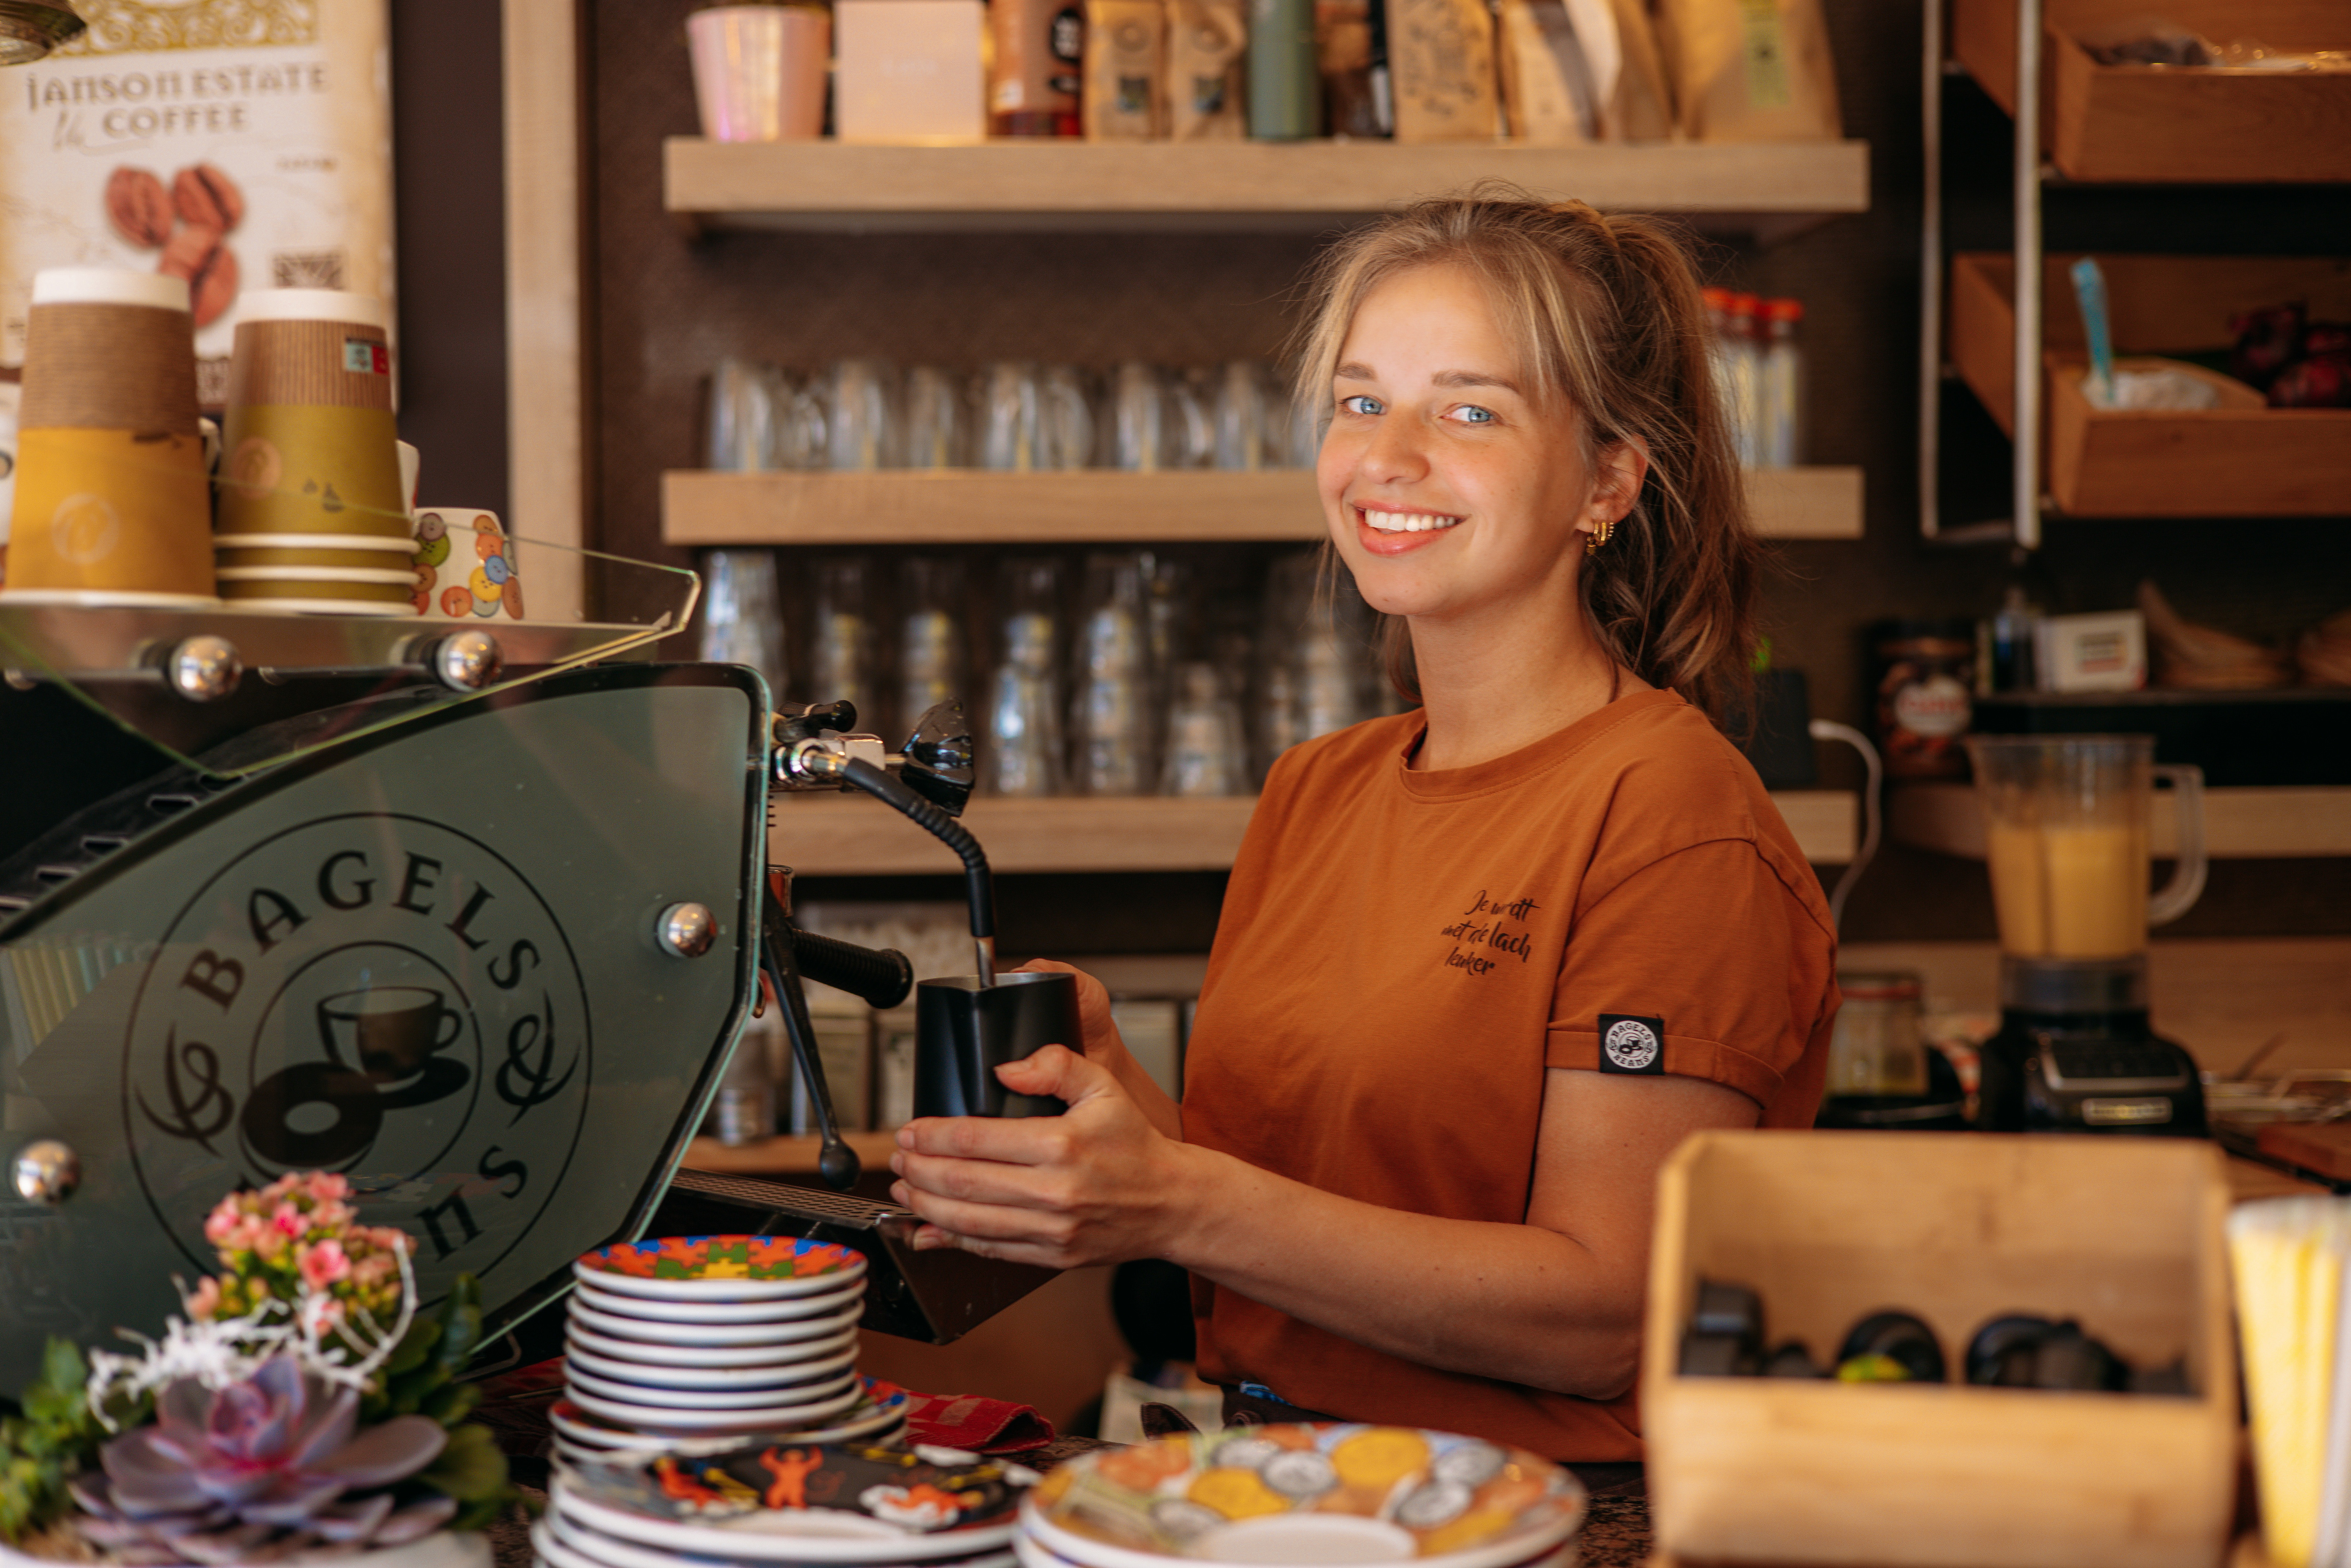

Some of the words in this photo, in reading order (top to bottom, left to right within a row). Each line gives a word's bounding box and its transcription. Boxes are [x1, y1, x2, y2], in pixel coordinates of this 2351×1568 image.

[193, 63, 328, 99] ESTATE
[102, 103, 248, 140] COFFEE
[1464, 890, 1489, 915] Je
[1489, 921, 1531, 963] lach
[179, 850, 541, 1012] BAGELS
[495, 987, 581, 1129] &
